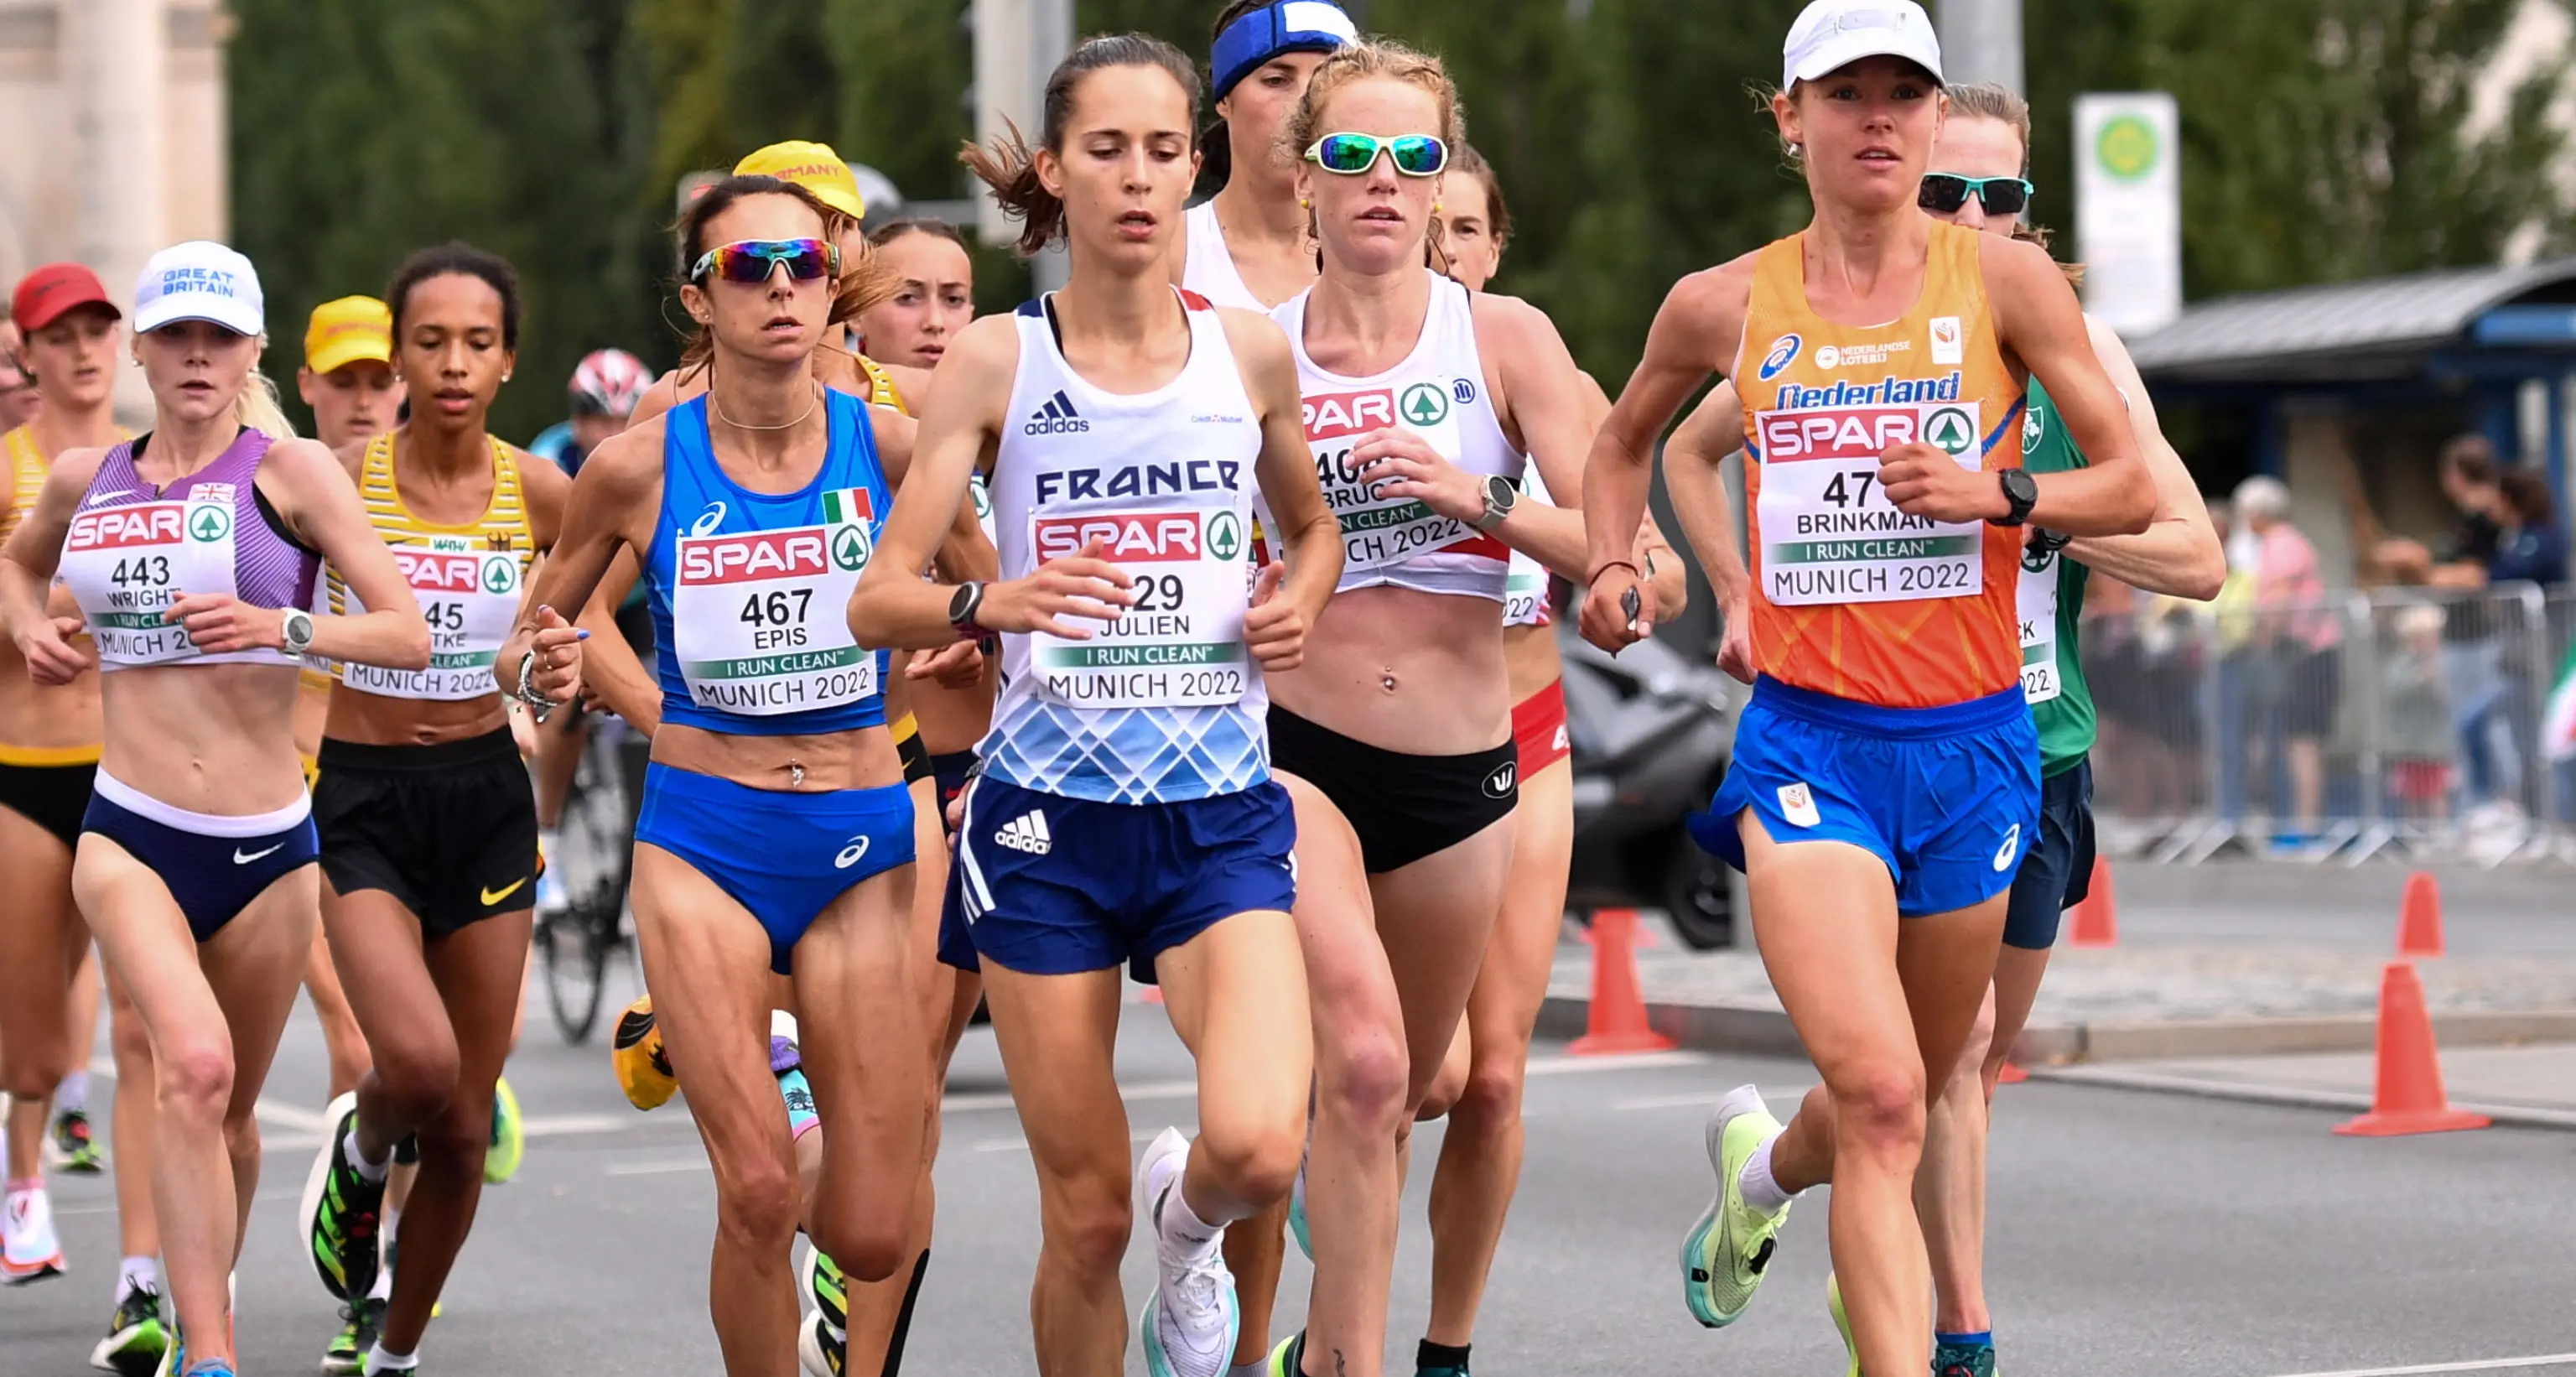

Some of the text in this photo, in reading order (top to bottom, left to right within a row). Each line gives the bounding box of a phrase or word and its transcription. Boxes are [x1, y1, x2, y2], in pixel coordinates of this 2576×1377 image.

[163, 281, 234, 298] BRITAIN
[164, 268, 234, 283] GREAT
[1841, 340, 1911, 356] NEDERLANDSE
[1024, 418, 1089, 436] adidas
[1768, 415, 1914, 456] SPAR
[1036, 460, 1239, 505] FRANCE
[1316, 448, 1384, 488] 40
[1322, 479, 1406, 510] BRU
[1823, 470, 1897, 508] 47
[70, 509, 181, 548] SPAR
[1393, 517, 1462, 554] 2022
[1797, 512, 1935, 534] BRINKMAN
[1040, 518, 1197, 559] SPAR
[1817, 543, 1857, 559] RUN
[111, 555, 171, 587] 443
[683, 536, 823, 579] SPAR
[1105, 574, 1184, 612] 29
[1774, 563, 1969, 596] MUNICH 2022
[740, 588, 813, 627] 467
[755, 627, 808, 650] EPIS
[1100, 615, 1190, 637] JULIEN
[2019, 620, 2036, 641] K
[101, 631, 164, 654] MUNICH
[1098, 648, 1140, 663] RUN
[351, 664, 492, 694] MUNICH 2022
[737, 660, 776, 676] RUN
[699, 668, 869, 707] MUNICH 2022
[1048, 670, 1243, 699] MUNICH 2022
